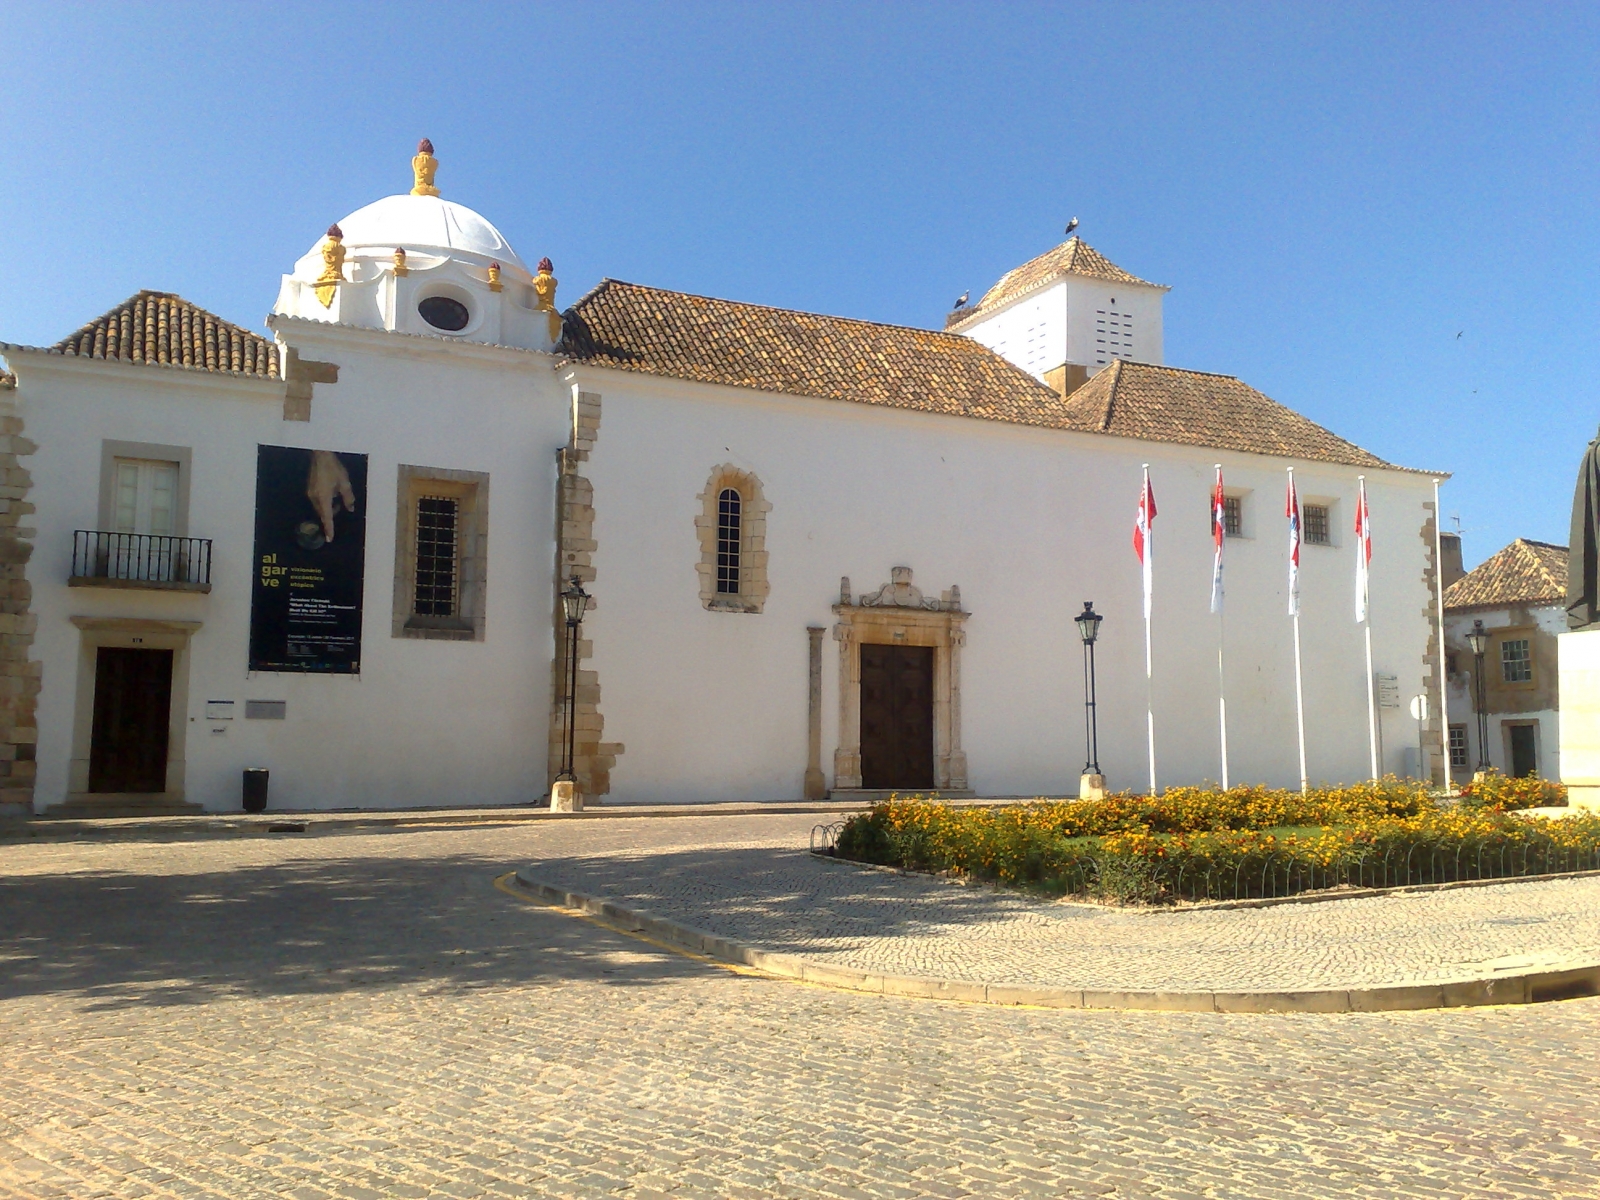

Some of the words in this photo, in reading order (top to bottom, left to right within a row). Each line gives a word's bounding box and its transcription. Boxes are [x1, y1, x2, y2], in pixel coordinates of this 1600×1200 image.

[262, 553, 277, 564] al
[262, 566, 288, 577] gar
[261, 578, 280, 587] ve
